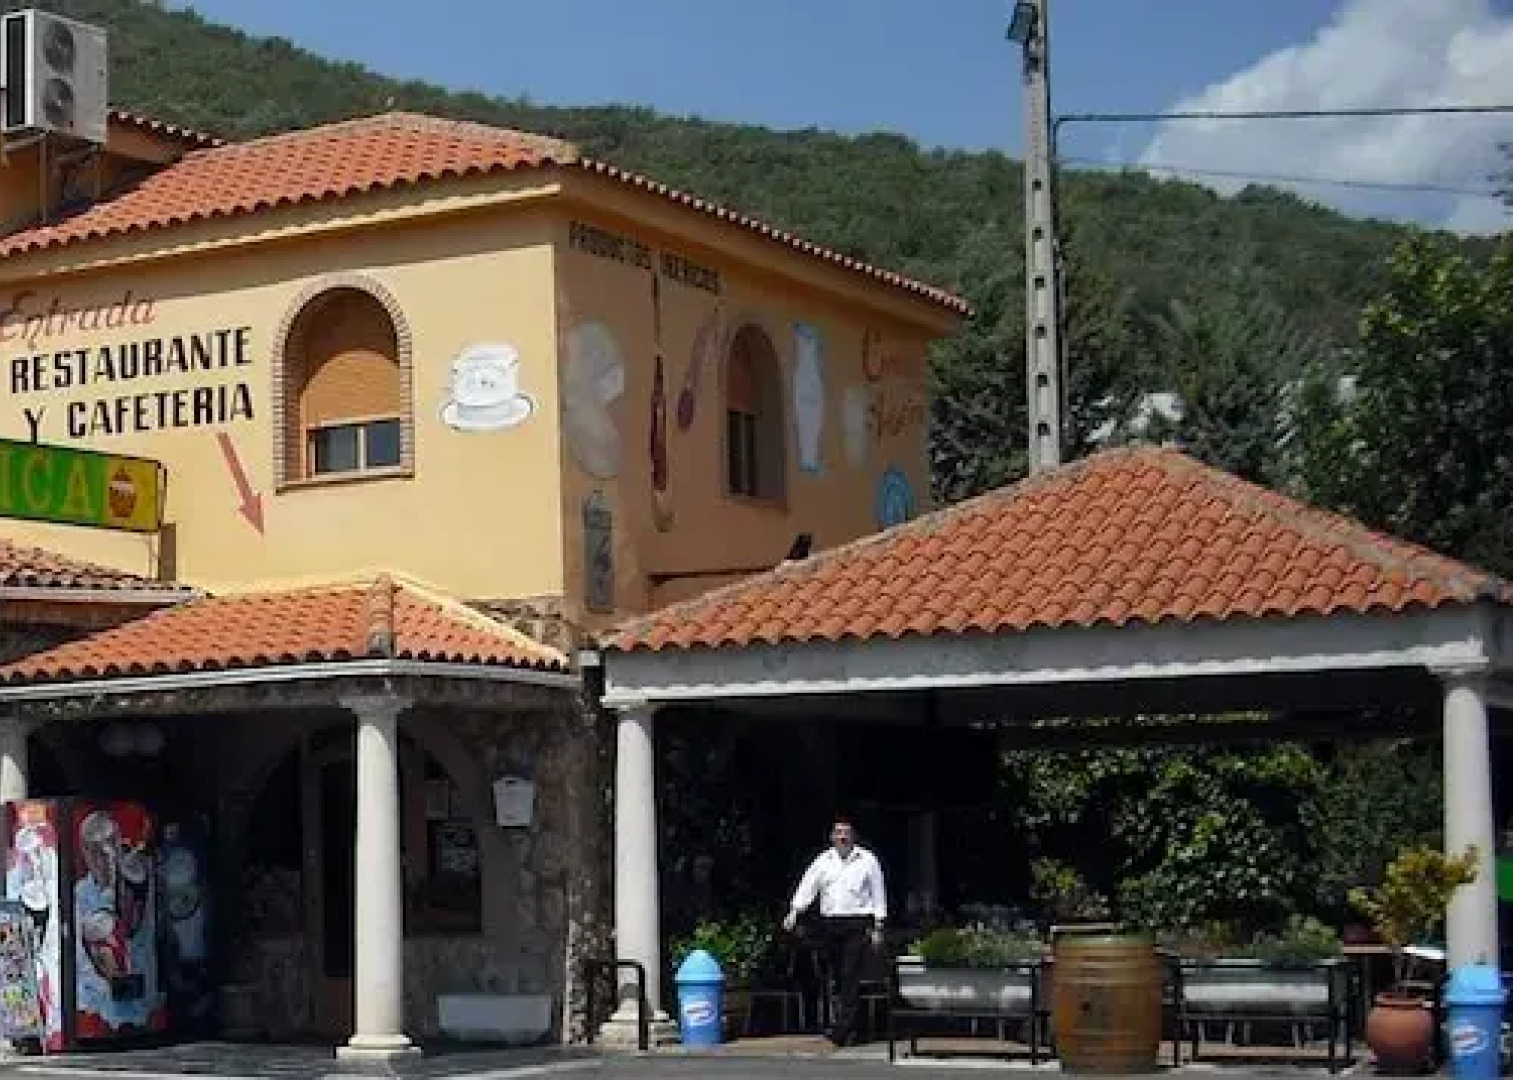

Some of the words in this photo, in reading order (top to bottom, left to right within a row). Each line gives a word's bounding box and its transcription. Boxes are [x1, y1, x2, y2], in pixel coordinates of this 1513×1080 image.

[10, 326, 253, 394] RESTAURANTE
[24, 406, 44, 444] Y
[69, 383, 254, 439] CAFETERIA
